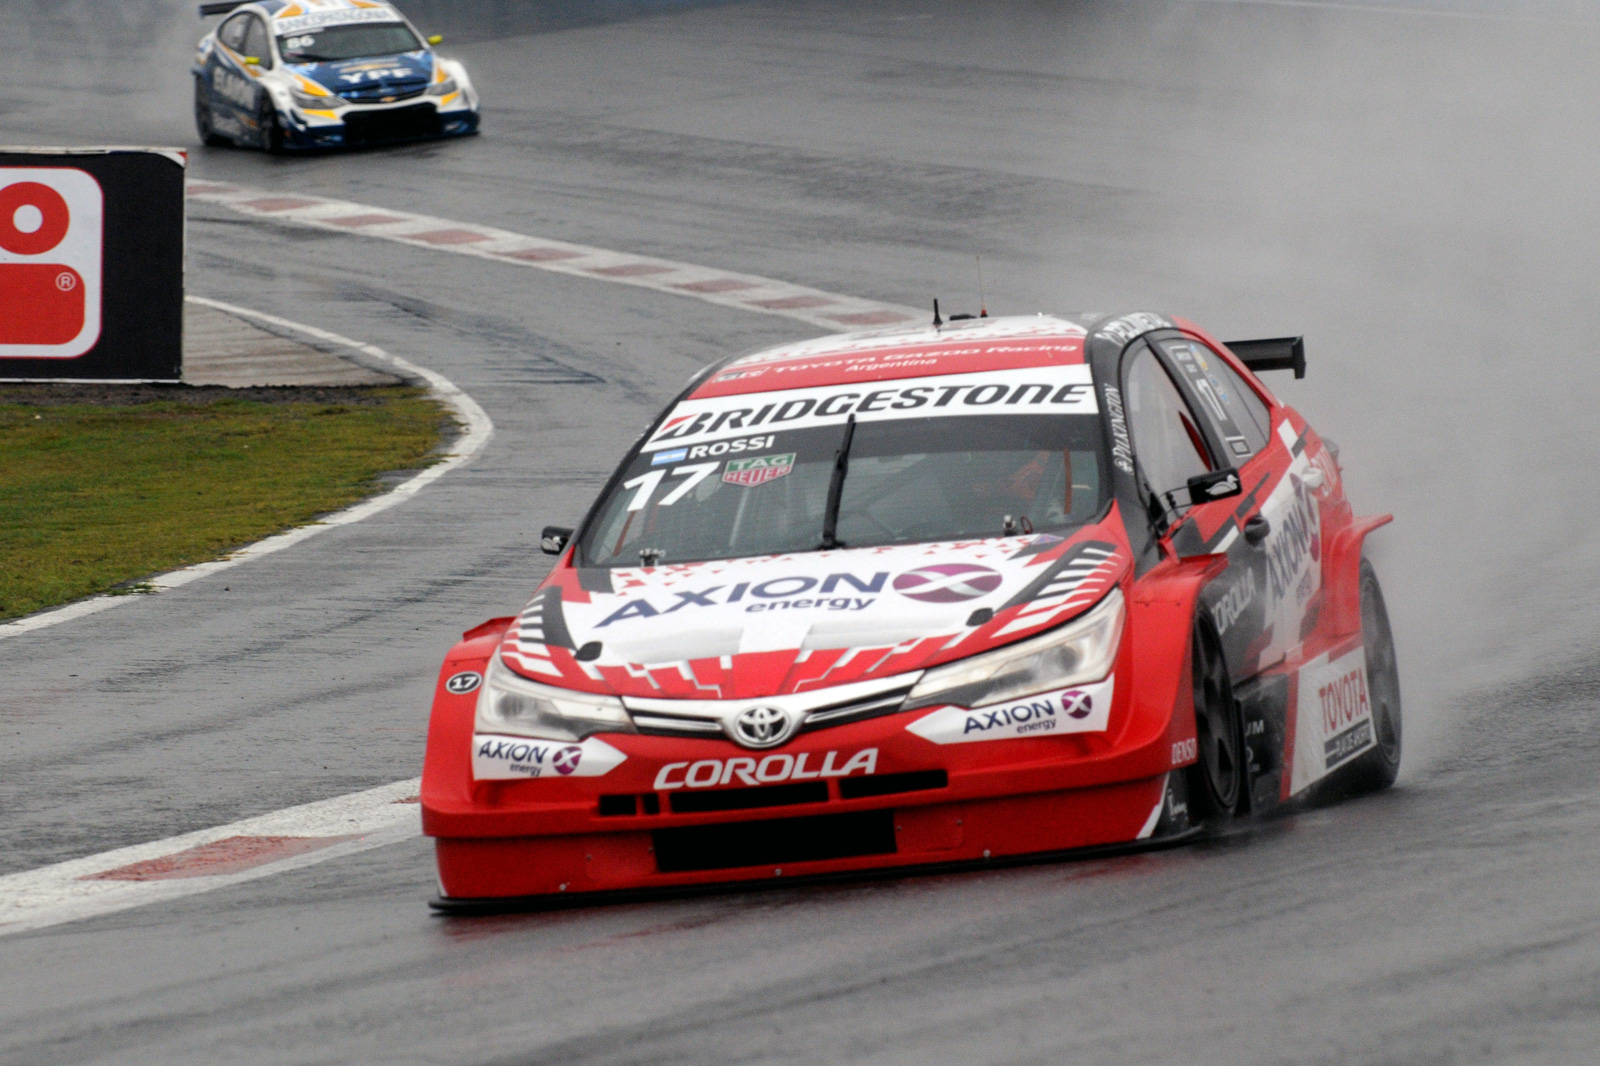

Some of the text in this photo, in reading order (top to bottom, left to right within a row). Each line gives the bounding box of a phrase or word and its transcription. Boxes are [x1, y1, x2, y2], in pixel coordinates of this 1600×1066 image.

[338, 67, 413, 84] YPF
[775, 356, 877, 373] TOYOTA
[883, 348, 981, 361] GAZOO
[845, 358, 938, 373] Argentina
[648, 382, 1095, 442] BRIDGESTONE
[1103, 383, 1133, 465] PILKINGTON
[688, 435, 776, 460] ROSSI
[725, 467, 791, 484] HEUER
[732, 455, 789, 471] TAG
[623, 461, 721, 512] 17
[592, 571, 891, 629] AXION
[745, 597, 877, 613] energy
[450, 675, 477, 690] 17
[1318, 666, 1369, 735] TOYOTA
[963, 699, 1056, 735] AXION
[1016, 718, 1057, 735] energy
[478, 740, 549, 764] AXION
[1171, 737, 1196, 766] DENSO
[510, 763, 543, 778] energy
[652, 748, 879, 791] COROLLA
